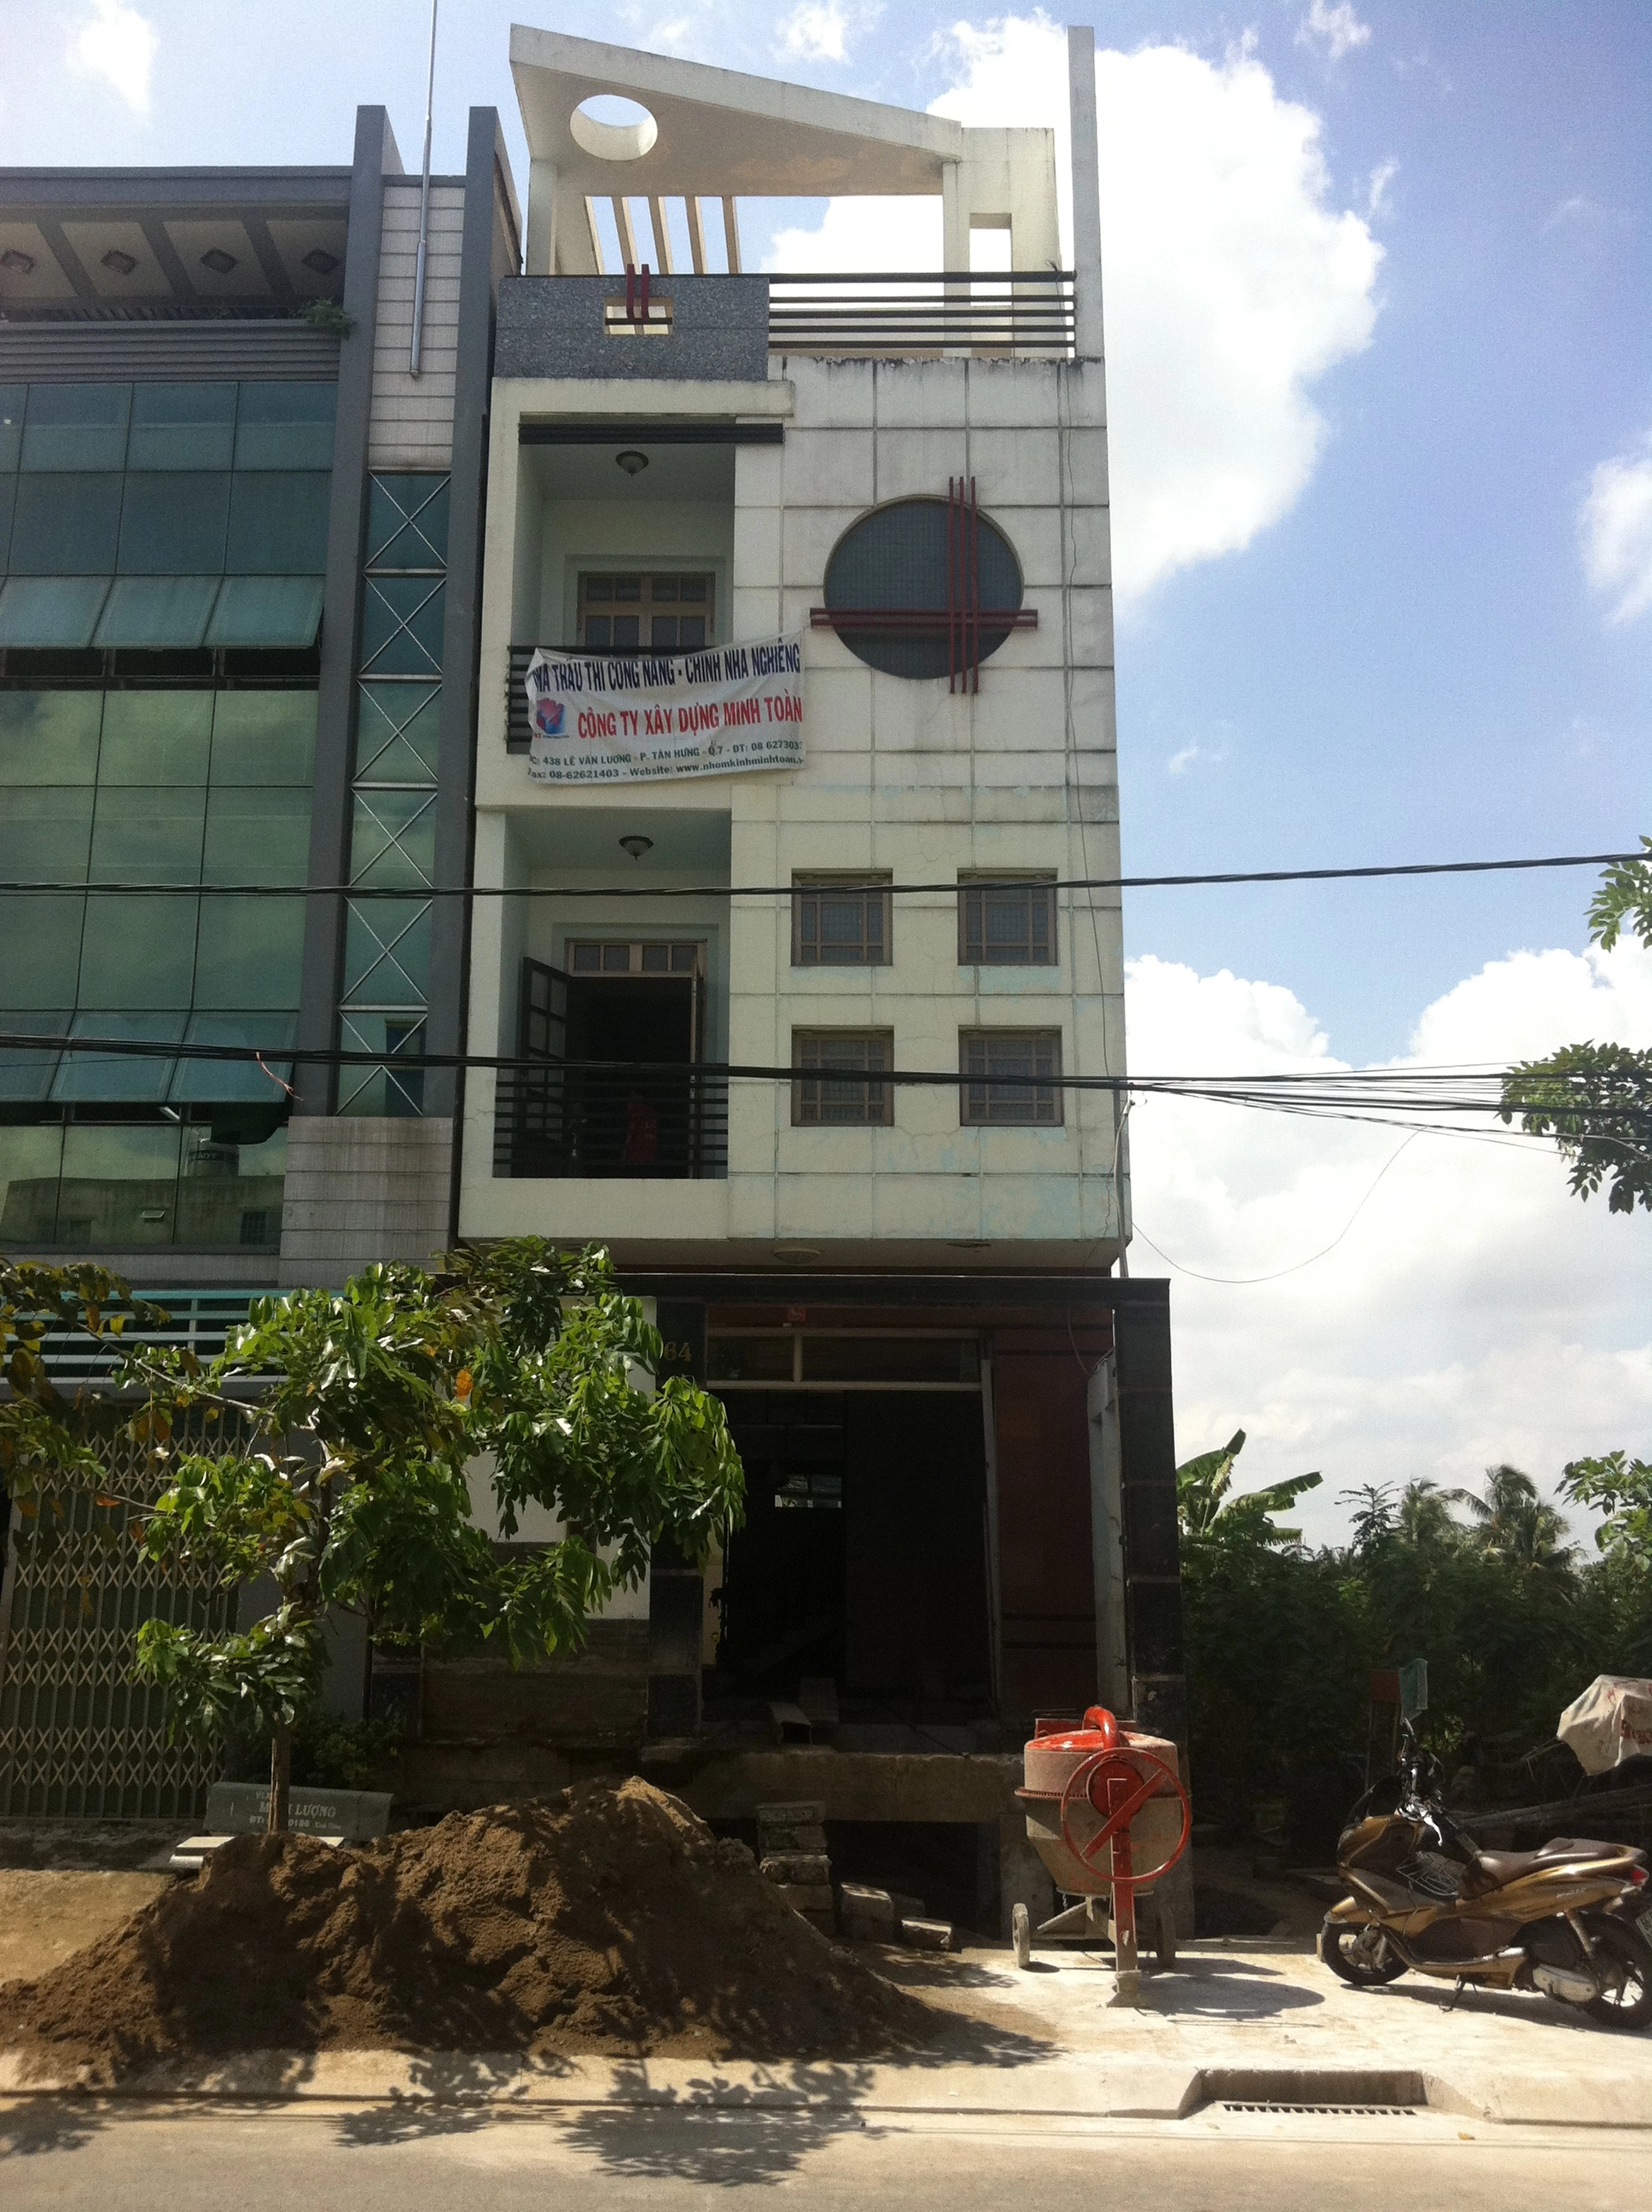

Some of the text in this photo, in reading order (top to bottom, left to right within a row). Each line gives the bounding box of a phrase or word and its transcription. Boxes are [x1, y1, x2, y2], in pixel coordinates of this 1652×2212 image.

[585, 661, 606, 691] THI
[578, 689, 803, 739] CÔNG TY XÂY DỰNG MINH TOÀN
[543, 756, 561, 766] 438
[751, 742, 763, 751] 08
